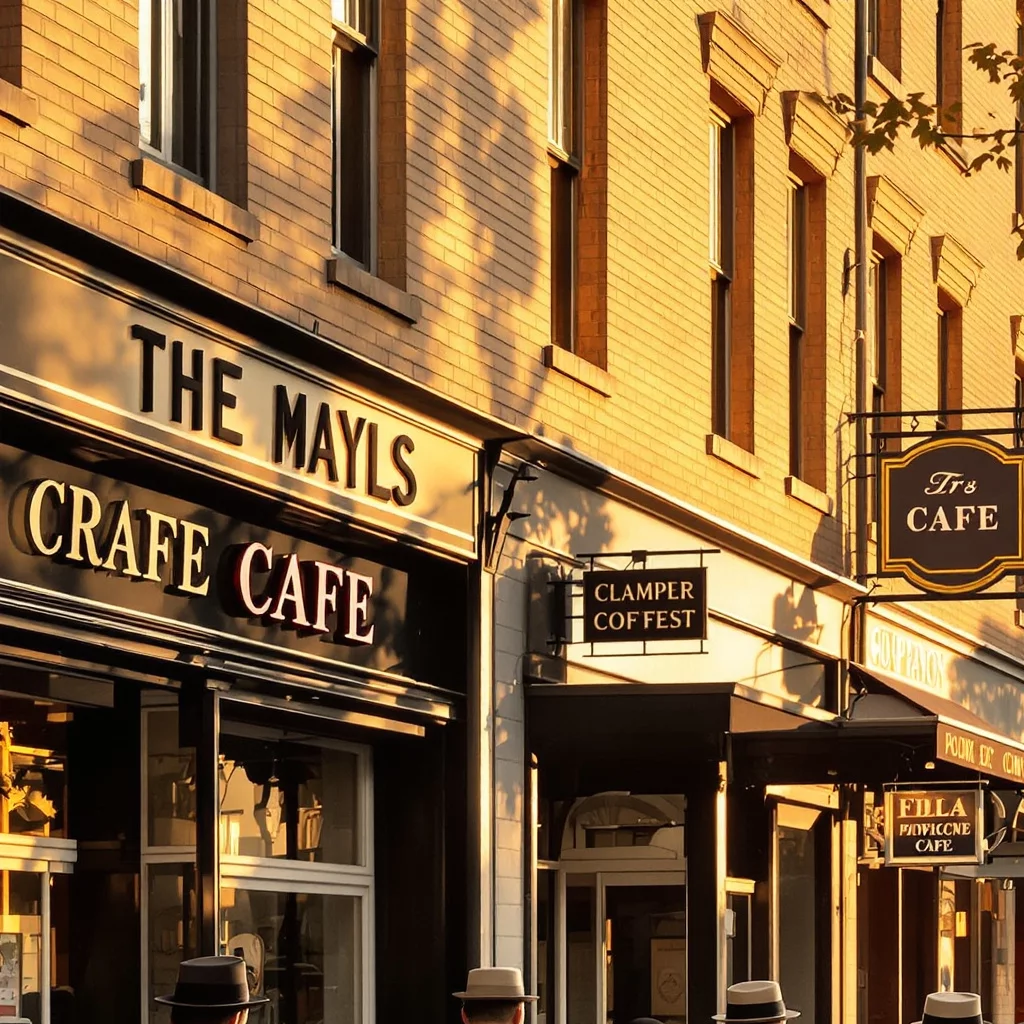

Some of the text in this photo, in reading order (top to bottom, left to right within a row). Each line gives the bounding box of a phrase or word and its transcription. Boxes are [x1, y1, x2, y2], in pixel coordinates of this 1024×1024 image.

[131, 324, 418, 507] THE MAYLS
[906, 504, 999, 532] CAFE
[28, 479, 375, 645] CRAFE CAFE
[594, 581, 695, 602] CLAMPER
[915, 839, 953, 853] CAFE
